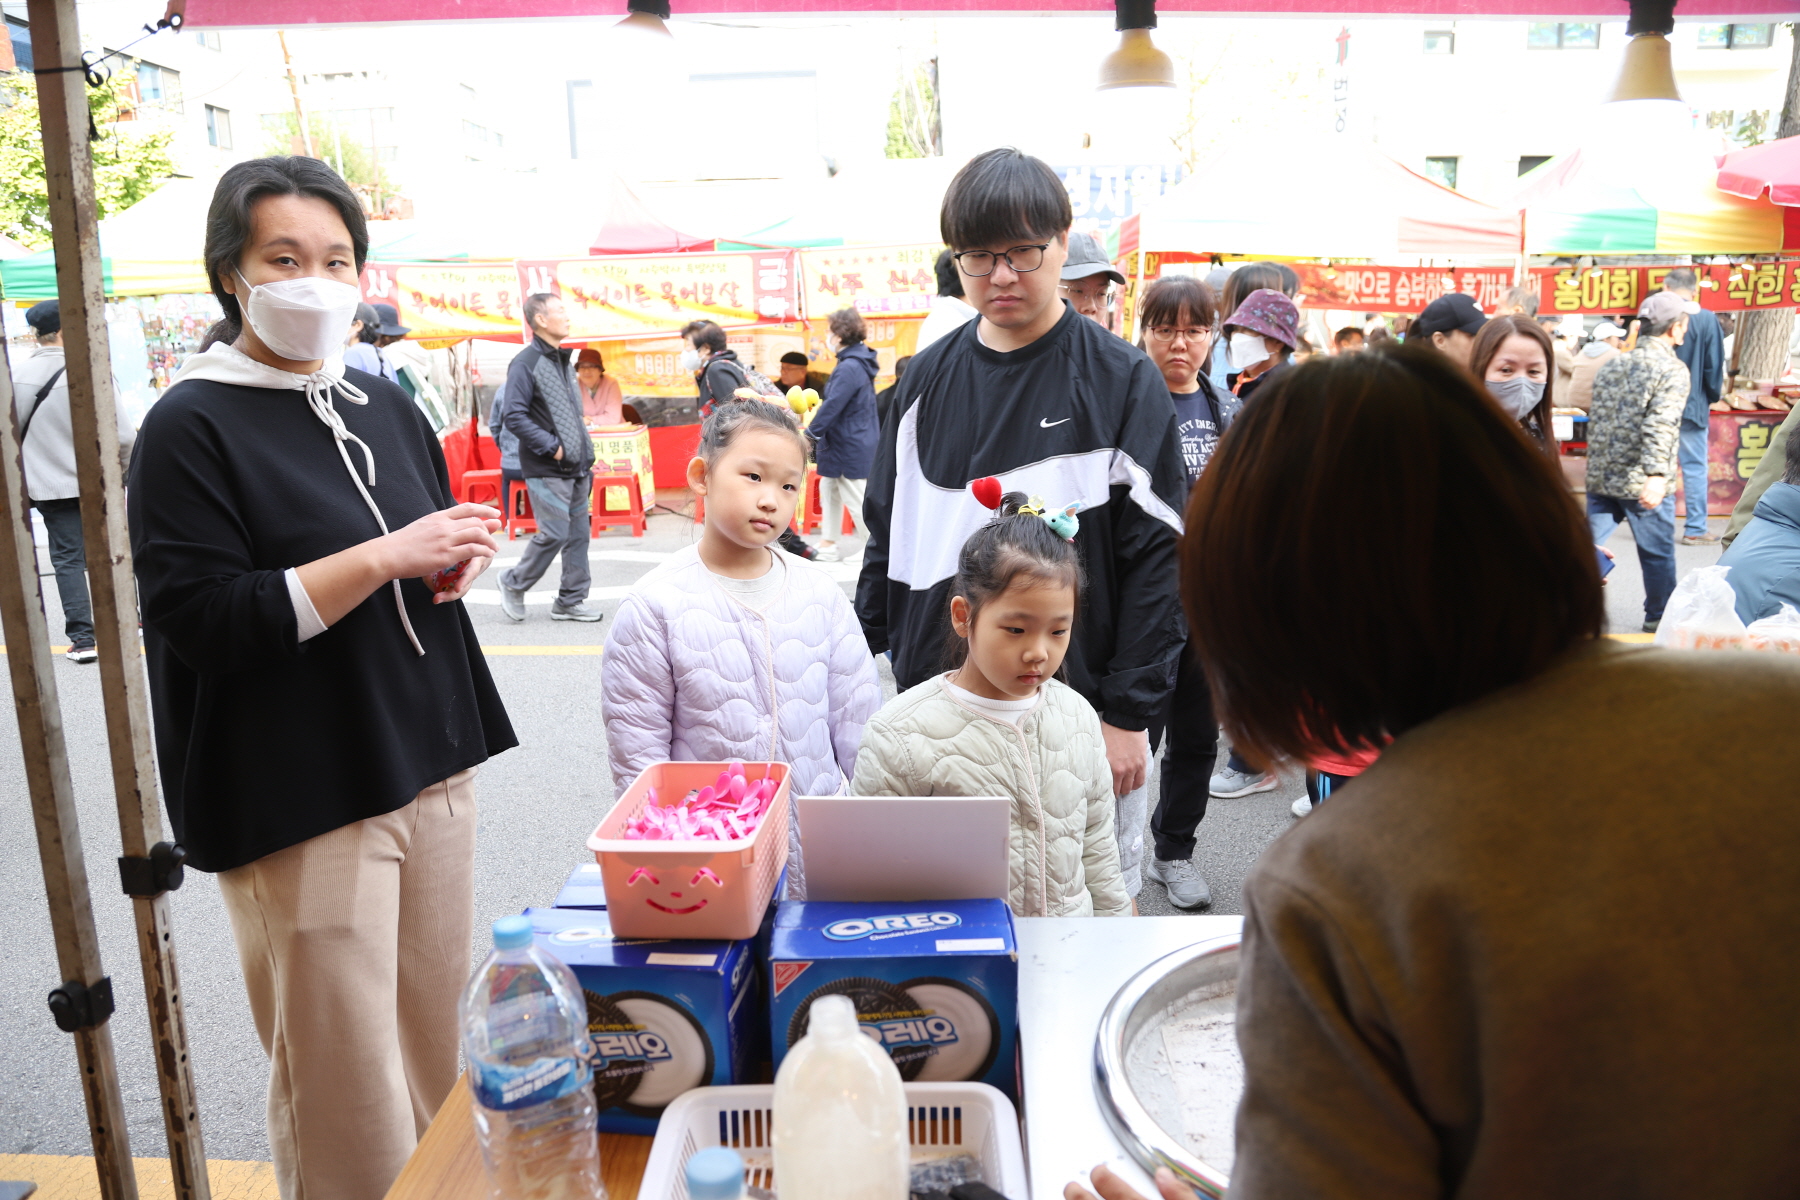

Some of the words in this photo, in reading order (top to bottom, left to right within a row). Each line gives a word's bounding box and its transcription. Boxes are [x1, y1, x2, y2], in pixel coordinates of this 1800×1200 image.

[366, 269, 393, 298] 사
[818, 273, 864, 296] 사주
[887, 268, 934, 293] 신수
[1344, 270, 1391, 304] 맛으로
[1553, 268, 1638, 311] 홍어회
[411, 291, 488, 317] 무엇이든
[571, 283, 652, 310] 무엇이든
[660, 280, 742, 313] 물어보살
[1195, 418, 1219, 432] ENER
[609, 440, 633, 454] 명품
[828, 911, 958, 937] OREO
